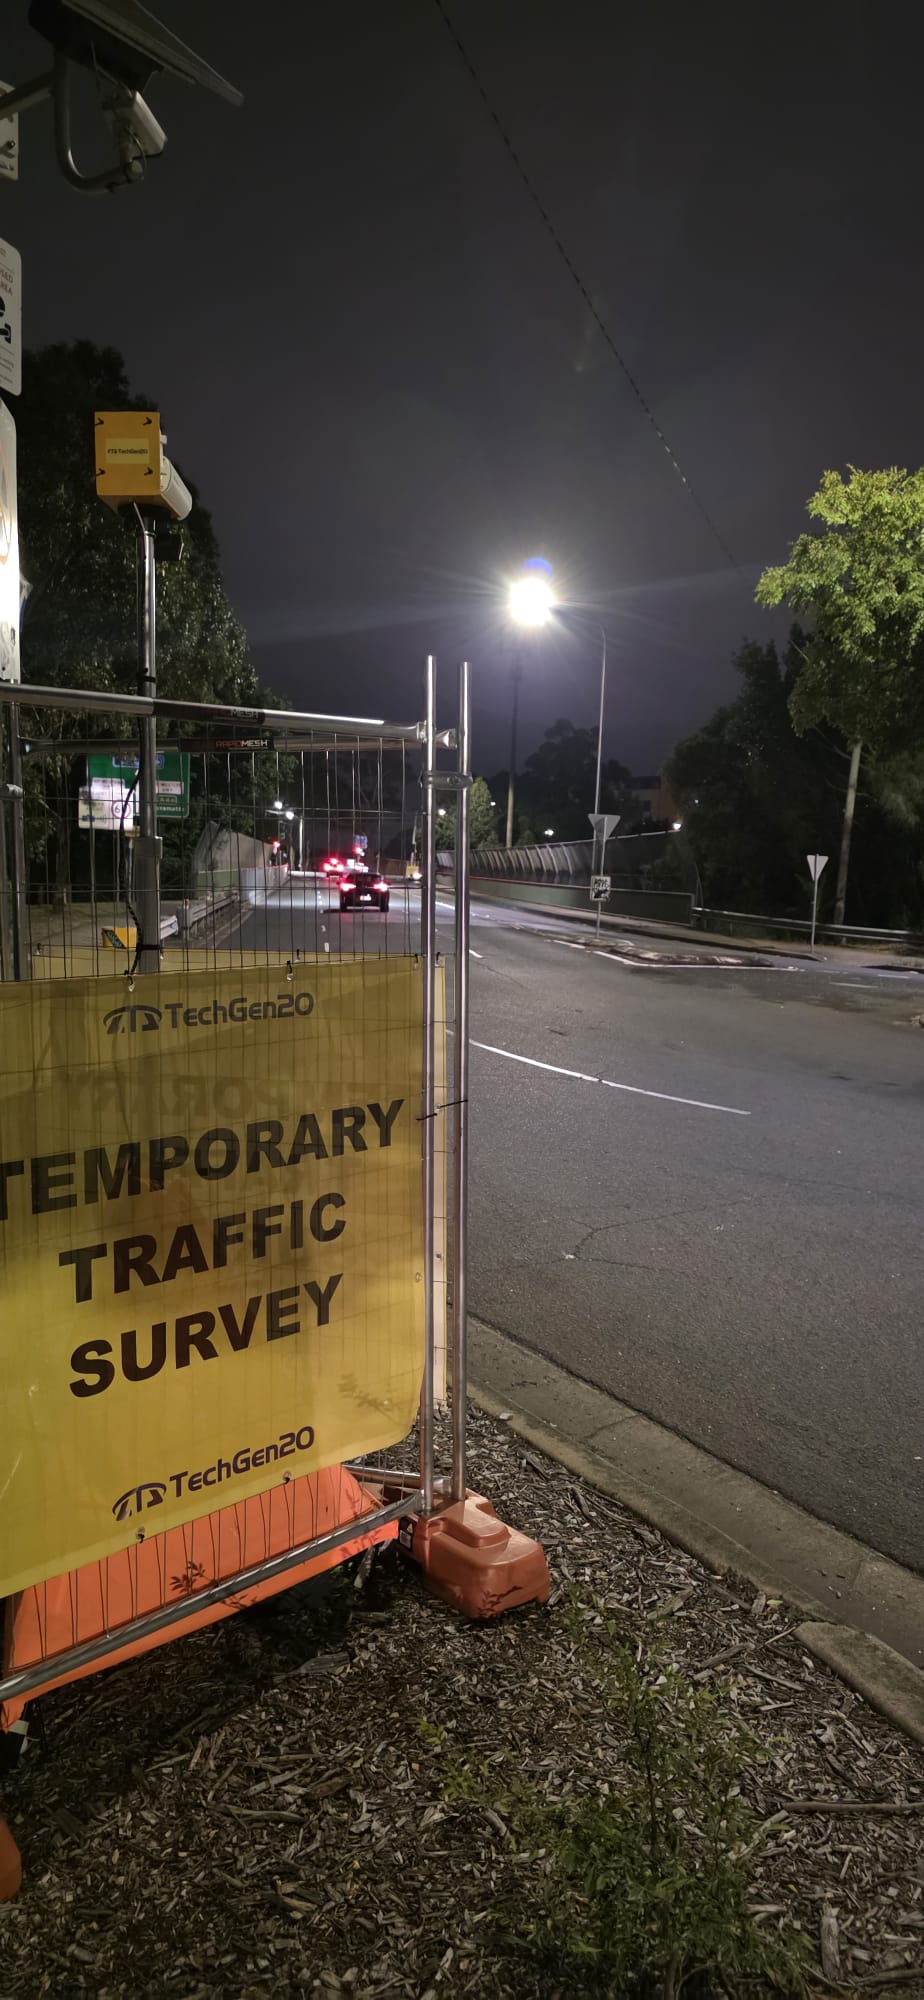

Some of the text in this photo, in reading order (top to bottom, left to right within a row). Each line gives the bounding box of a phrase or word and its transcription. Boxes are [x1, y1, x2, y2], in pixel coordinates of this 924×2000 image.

[164, 992, 314, 1029] TechGen20
[59, 1192, 346, 1303] TRAFFIC
[69, 1273, 343, 1398] SURVEY
[169, 1426, 314, 1497] TechGen20
